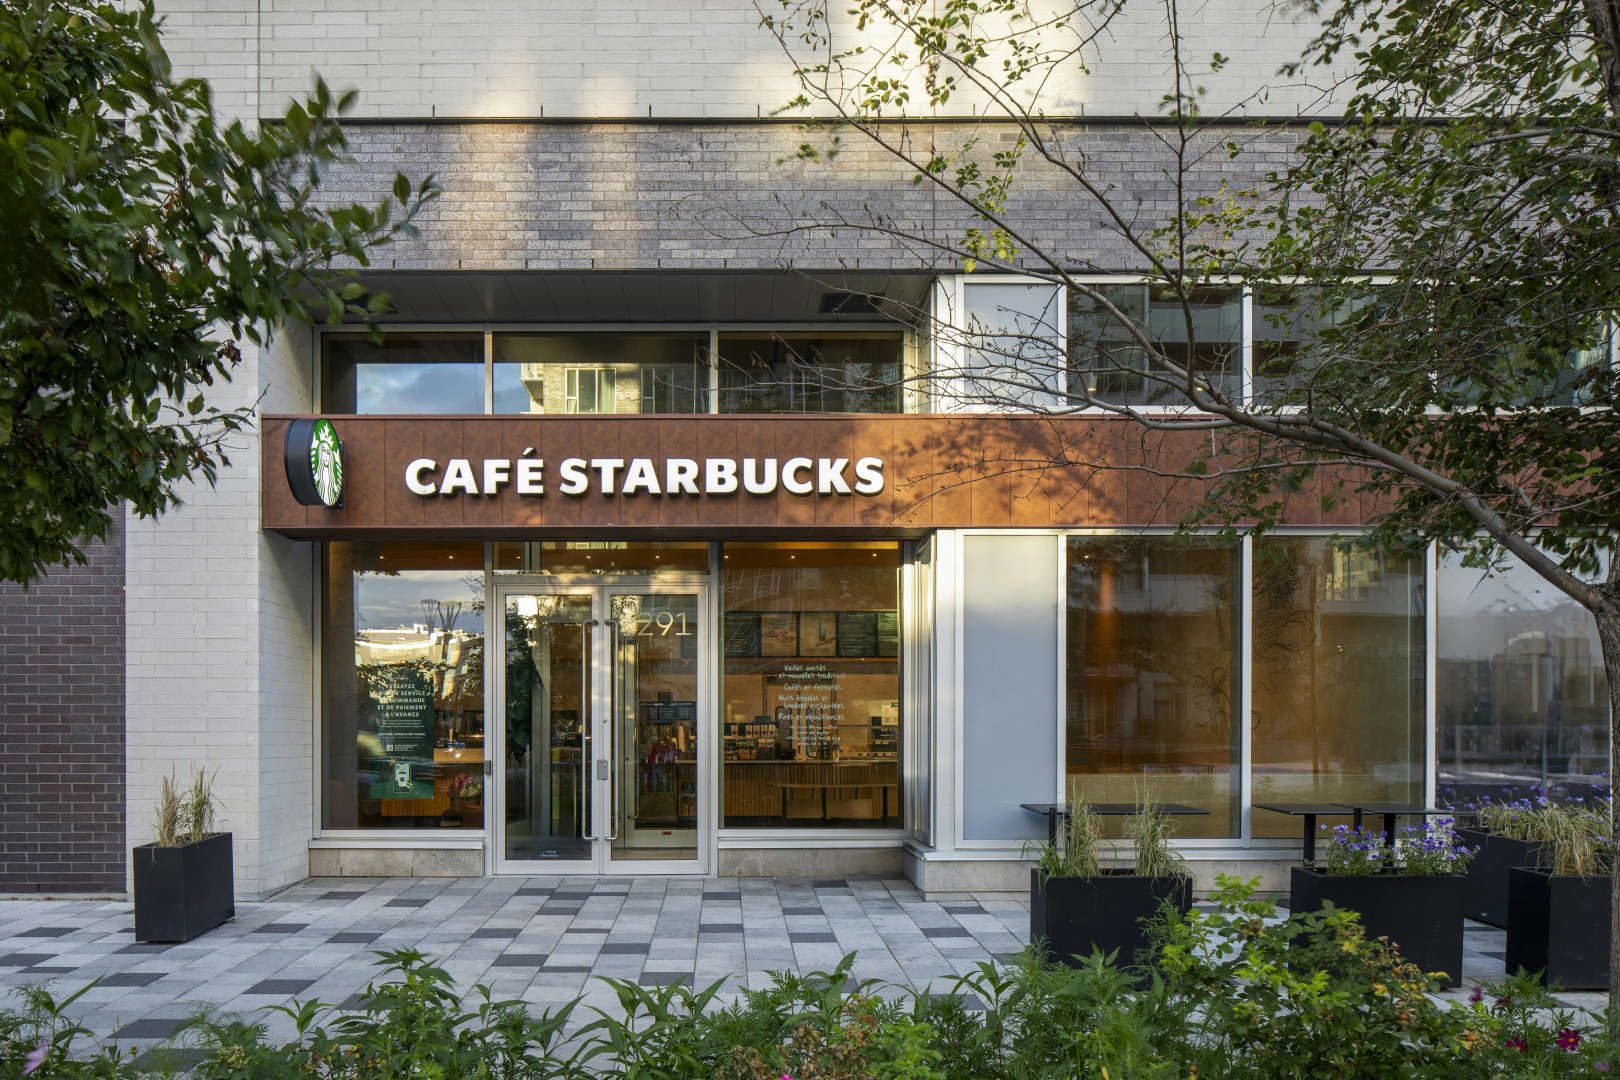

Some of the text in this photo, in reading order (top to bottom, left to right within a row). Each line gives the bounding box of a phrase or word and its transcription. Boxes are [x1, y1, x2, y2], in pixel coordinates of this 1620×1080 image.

[405, 447, 885, 496] CAFÉ STARBUCKS
[638, 612, 691, 635] 291
